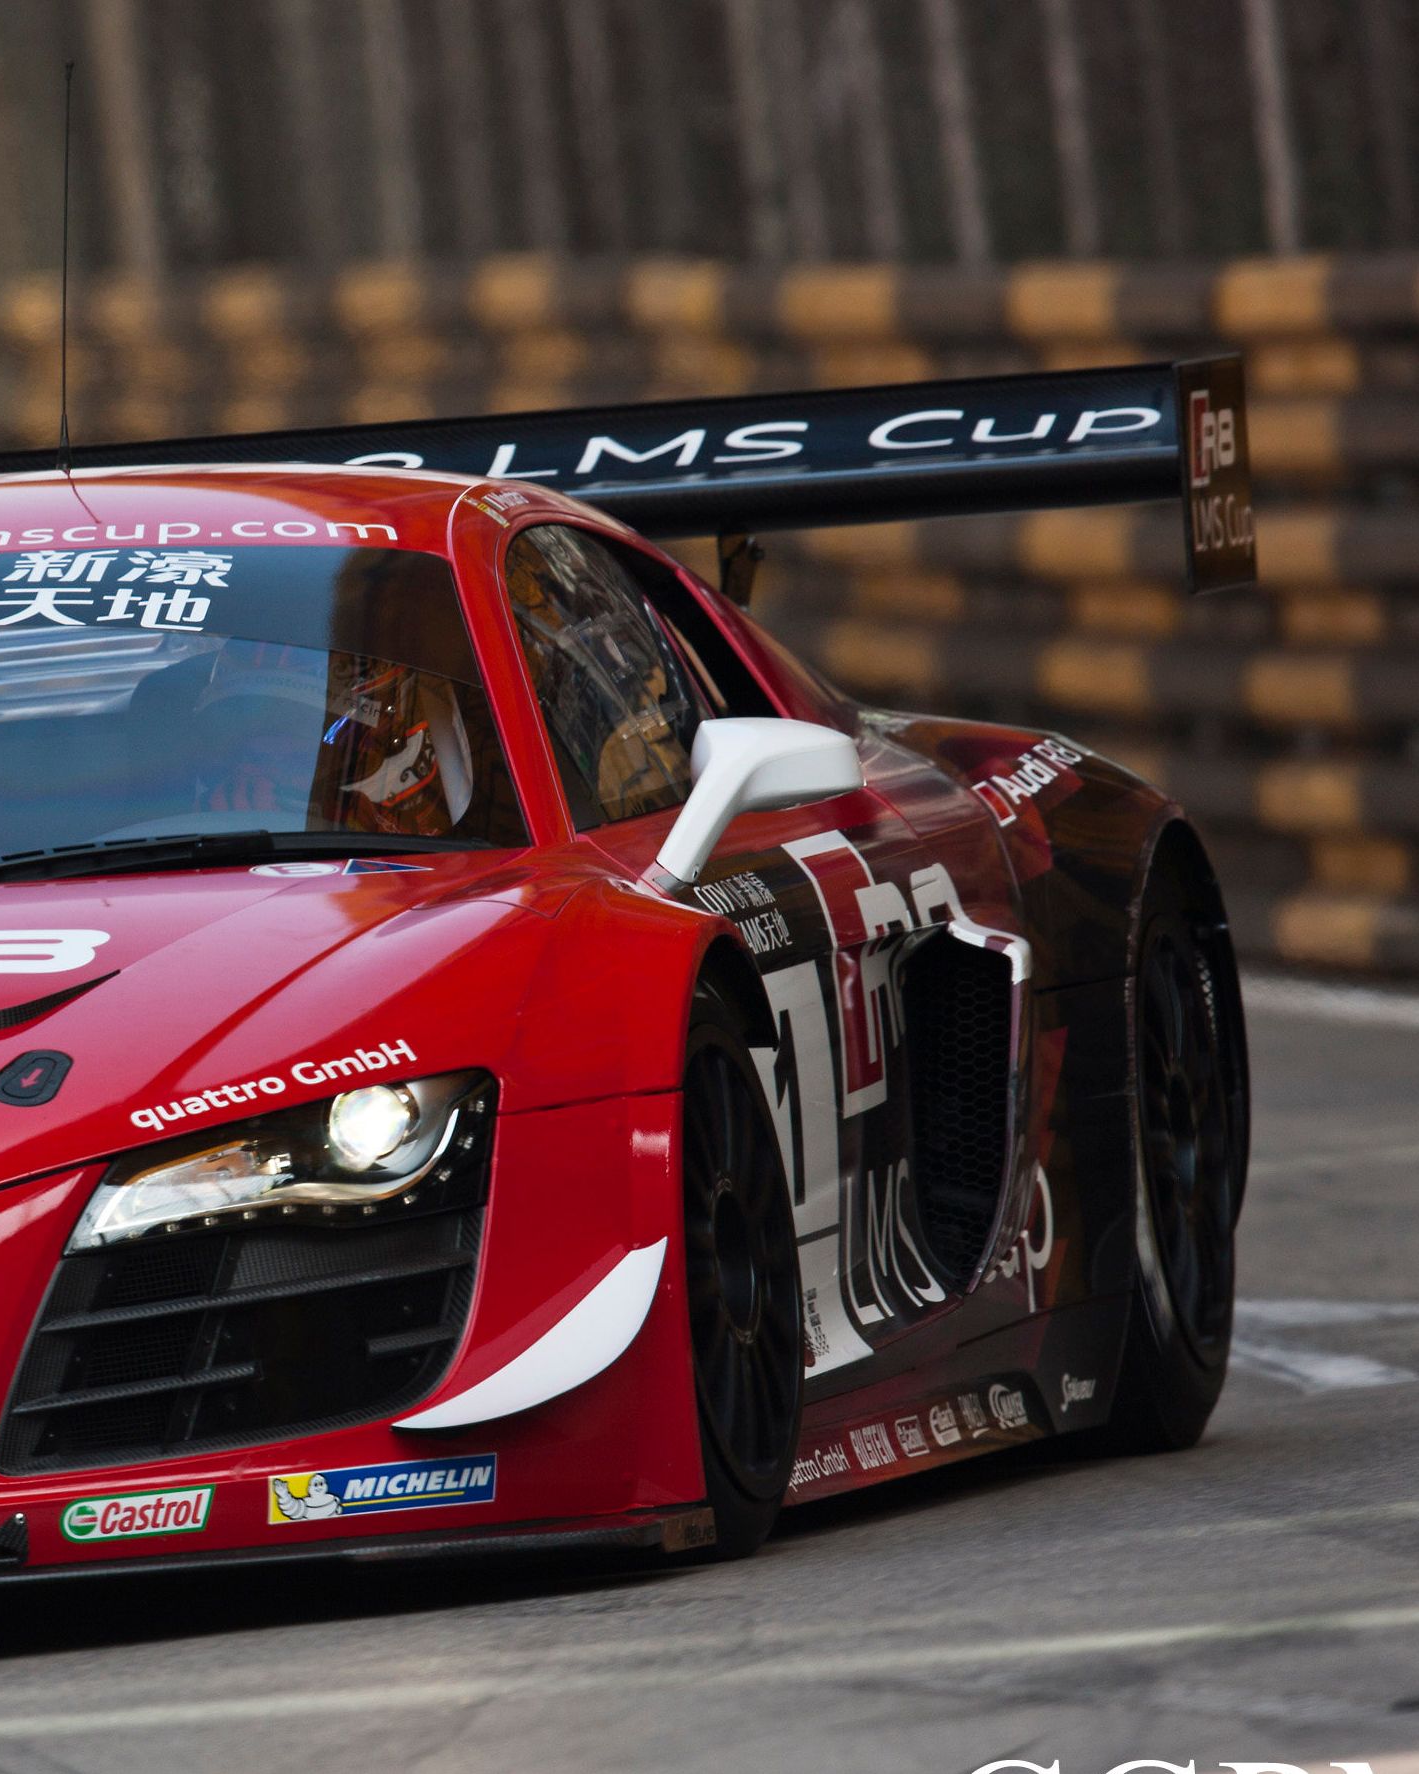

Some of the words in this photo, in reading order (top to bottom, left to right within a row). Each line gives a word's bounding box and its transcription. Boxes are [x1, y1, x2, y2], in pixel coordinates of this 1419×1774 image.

[486, 421, 809, 477] LMS
[868, 406, 1162, 450] Cup
[1193, 496, 1223, 551] LMS
[2, 549, 233, 588] 新濠
[990, 753, 1059, 805] Audi
[1032, 738, 1083, 770] R8
[130, 1076, 286, 1132] quattro
[290, 1038, 418, 1085] GmbH
[846, 1157, 946, 1326] LMS
[343, 1465, 493, 1500] MICHELIN
[815, 1442, 851, 1477] GmbH
[99, 1492, 203, 1535] Castrol
